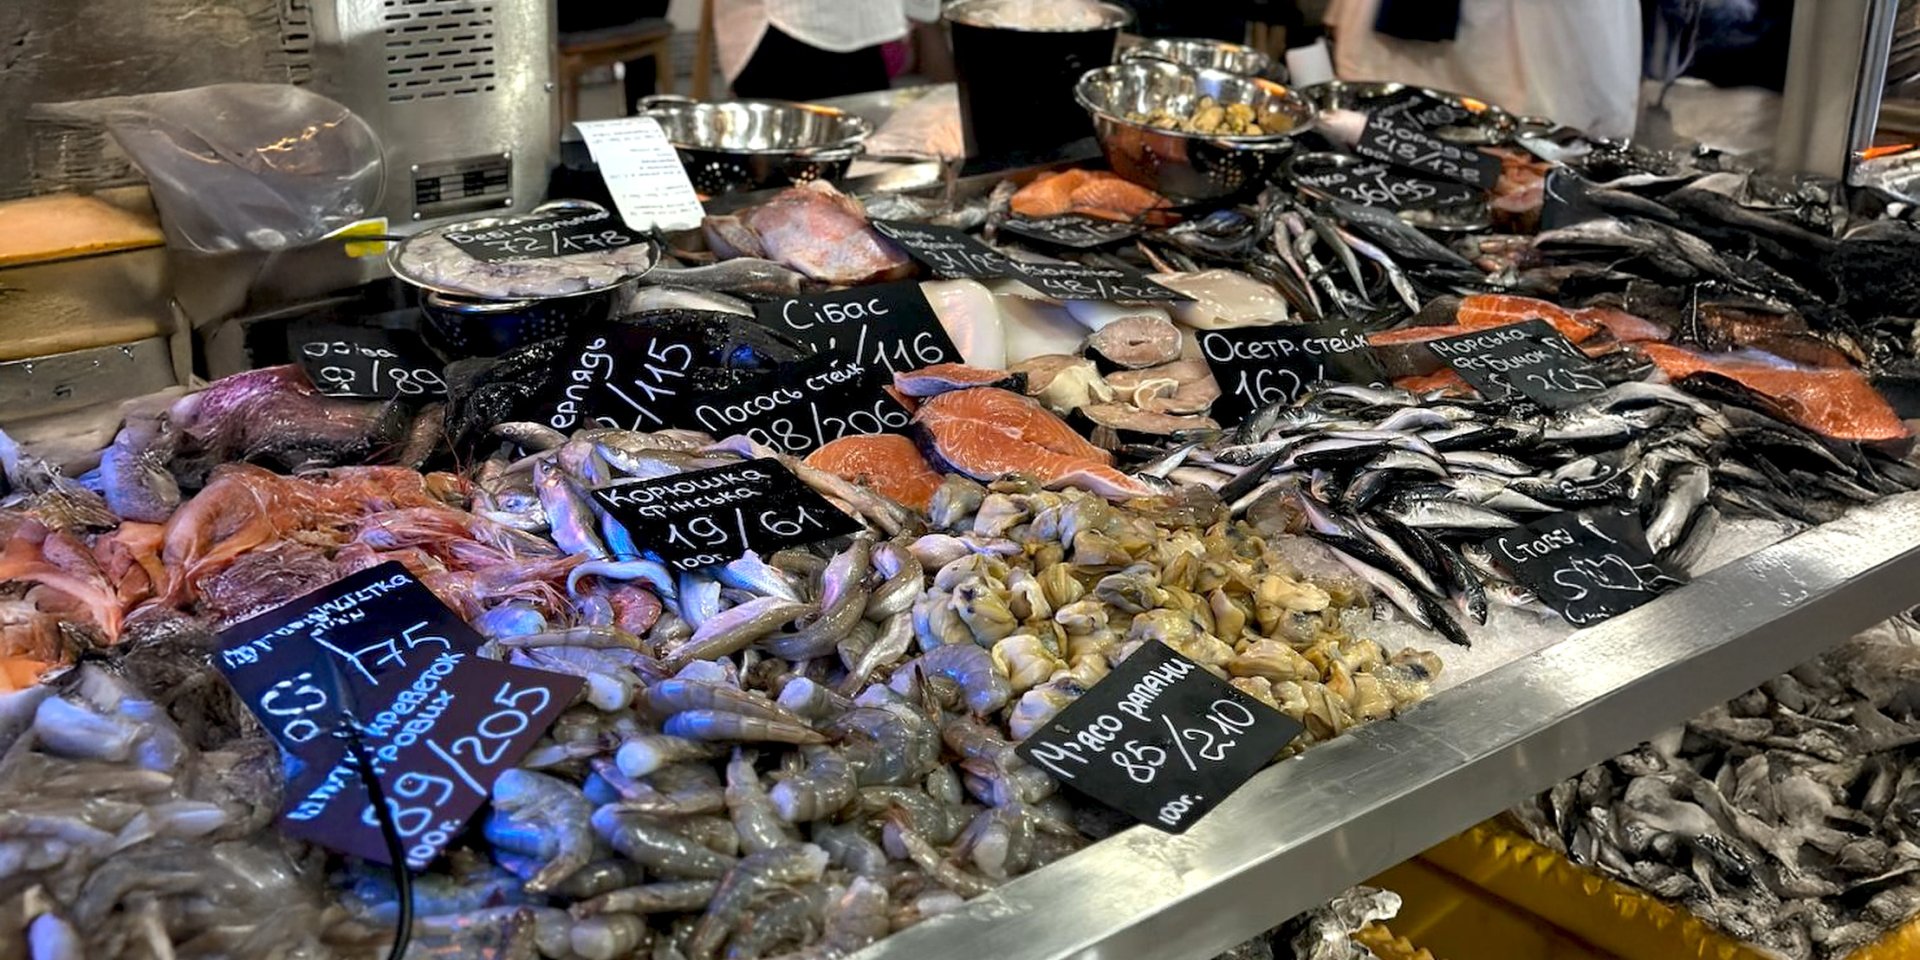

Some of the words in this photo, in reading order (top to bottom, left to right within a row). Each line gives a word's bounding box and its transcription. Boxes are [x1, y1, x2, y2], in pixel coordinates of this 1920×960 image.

[483, 230, 631, 255] 72/178
[782, 298, 890, 330] Сібас
[1203, 332, 1300, 363] Осетр.
[1302, 328, 1371, 355] стейк
[550, 337, 614, 429] ерлядь
[695, 388, 804, 432] Лосось
[805, 360, 866, 392] стейк
[598, 469, 772, 508] Корюшка
[638, 486, 763, 519] фінська
[668, 505, 830, 550] 19/61
[363, 652, 466, 737] креветок
[374, 687, 455, 775] грових
[1111, 699, 1256, 784] 85/210
[361, 682, 551, 837] 89/205
[1158, 794, 1204, 826] 100г.
